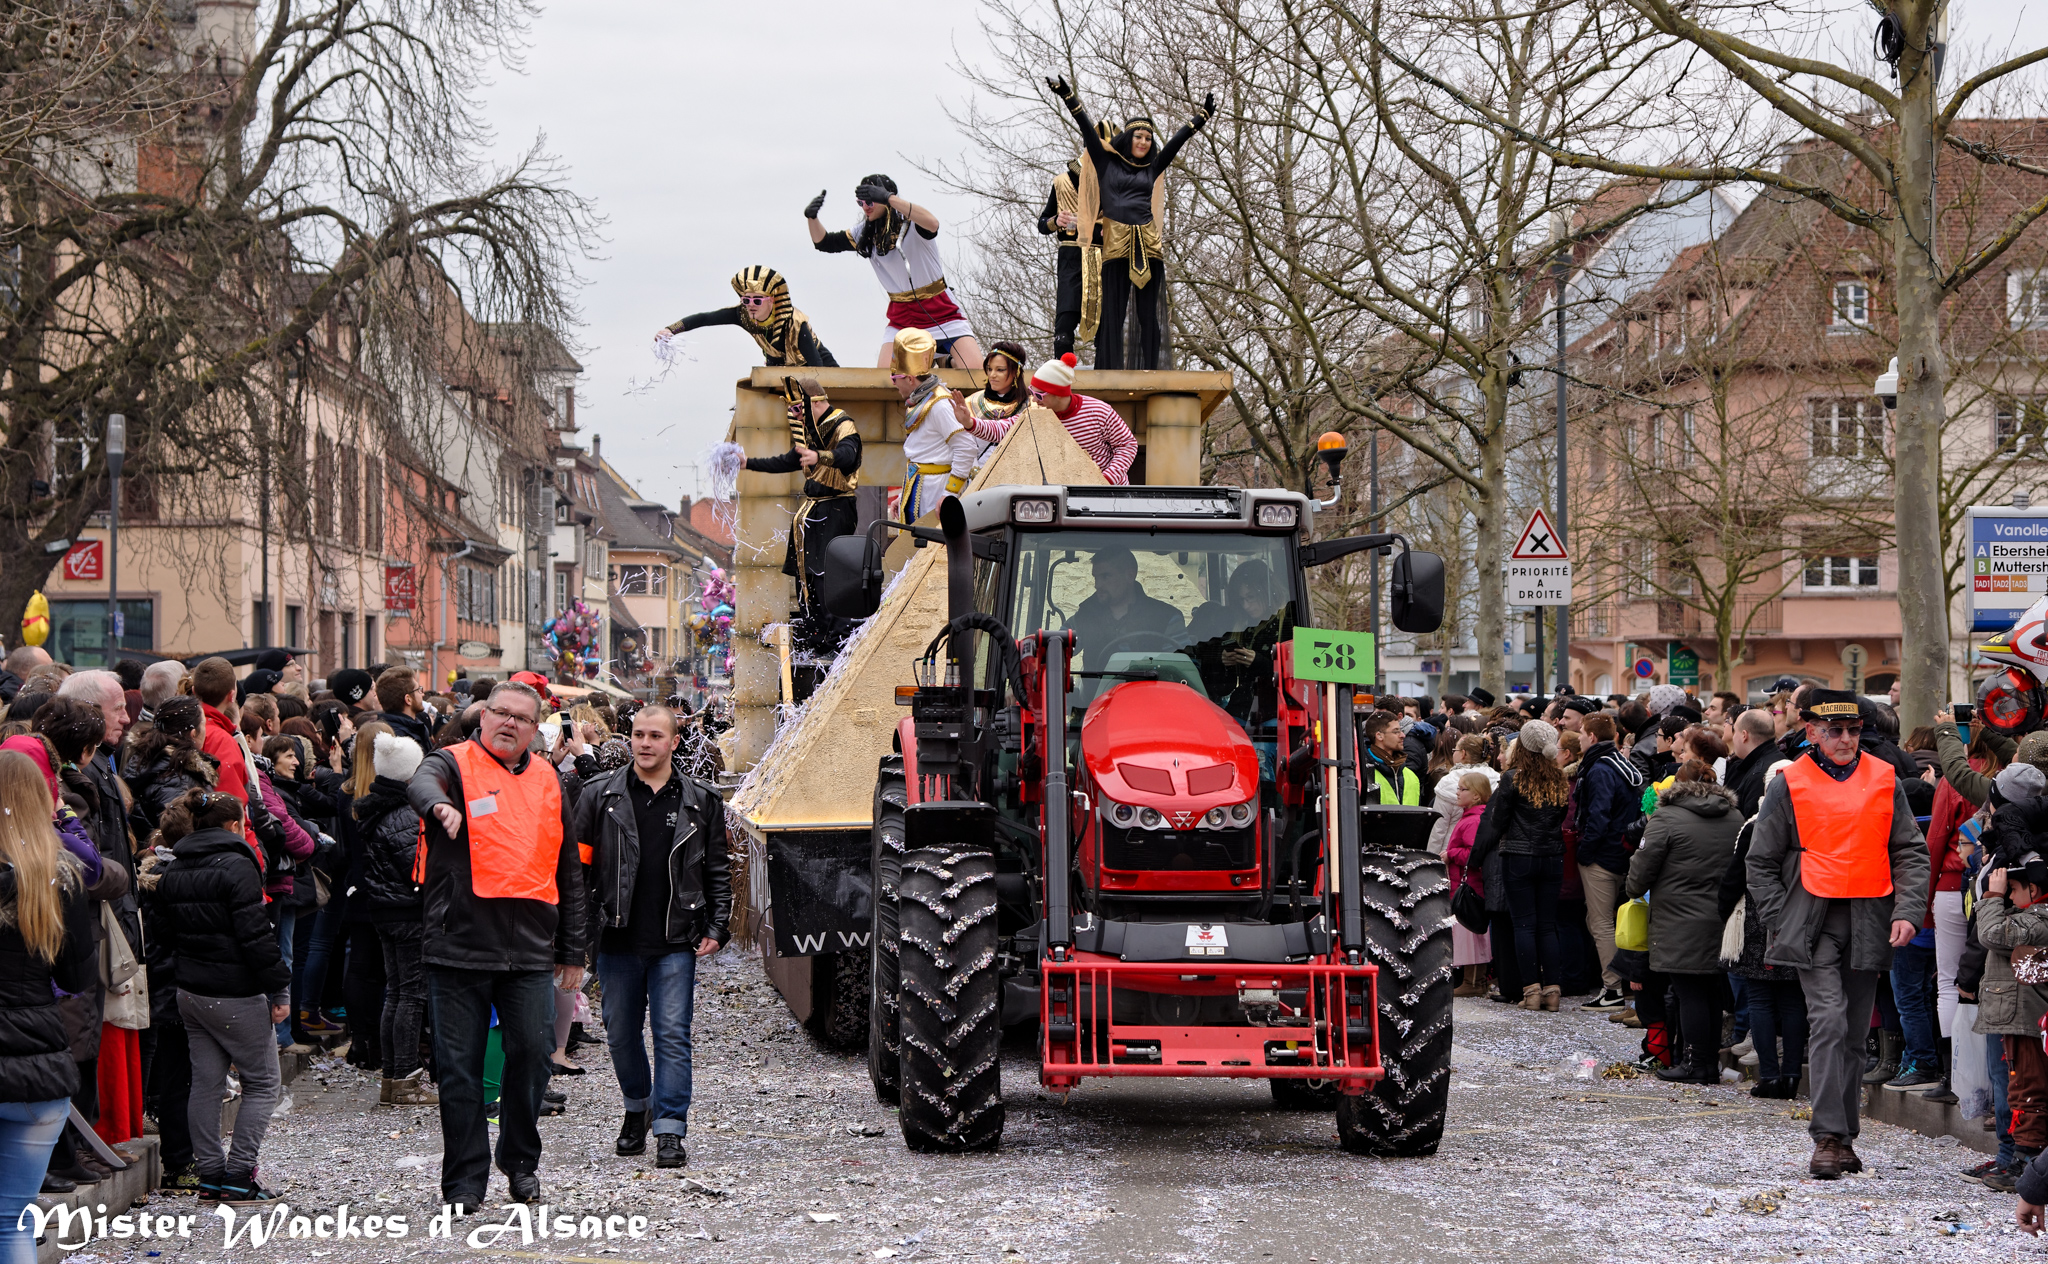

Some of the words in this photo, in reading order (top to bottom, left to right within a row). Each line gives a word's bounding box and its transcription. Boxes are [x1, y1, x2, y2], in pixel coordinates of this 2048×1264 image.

[1976, 545, 1987, 557] A
[1512, 565, 1569, 576] PRIORITÉ
[1978, 561, 1986, 572] B
[1537, 579, 1544, 588] A
[1975, 580, 1991, 588] TAD1
[1993, 580, 2009, 588] TAD2
[2011, 580, 2028, 588] TAD3
[1519, 590, 1562, 599] DROITE
[1313, 641, 1356, 670] 38
[1820, 704, 1855, 713] MACHORES
